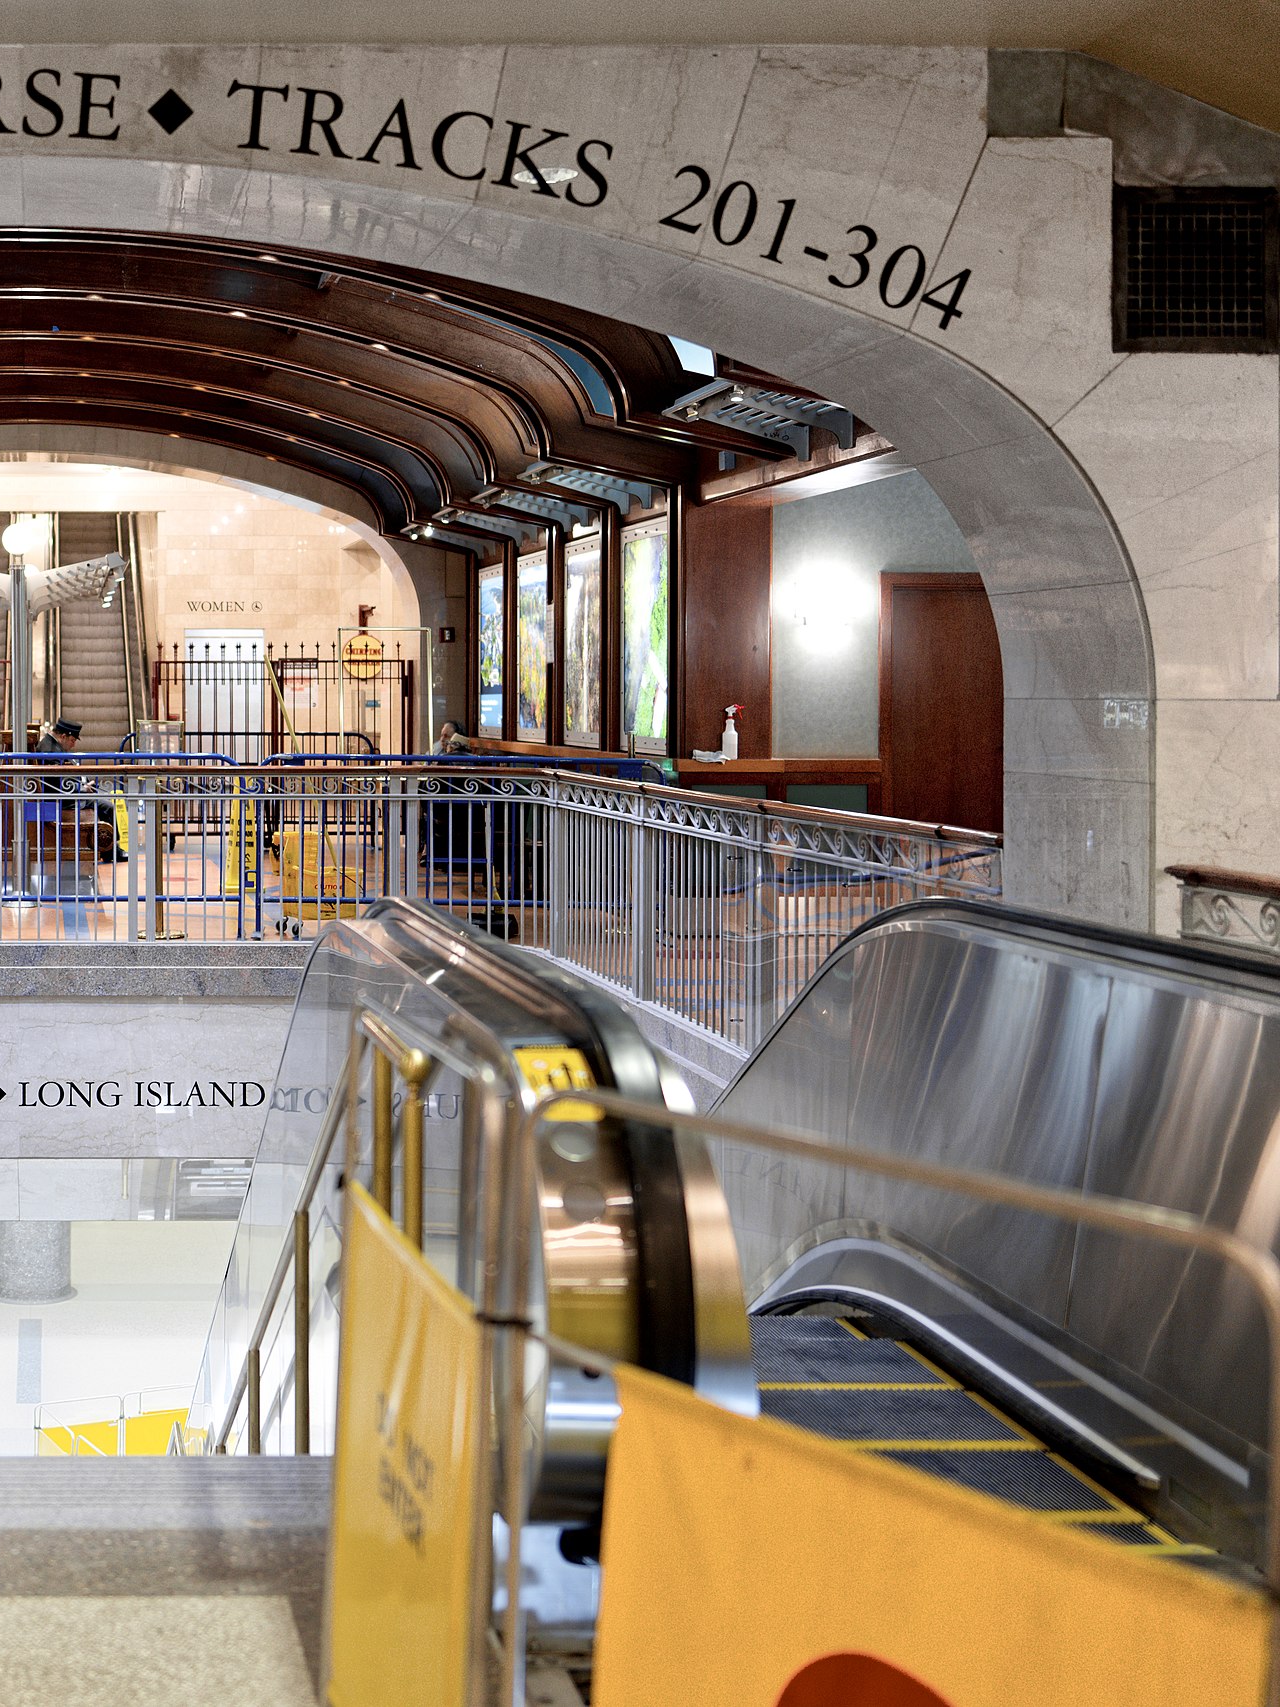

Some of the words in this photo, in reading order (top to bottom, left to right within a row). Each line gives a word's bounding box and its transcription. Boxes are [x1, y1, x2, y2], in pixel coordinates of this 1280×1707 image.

[227, 79, 613, 208] TRACKS
[658, 164, 972, 331] 201-304
[187, 601, 245, 612] WOMEN
[18, 1081, 124, 1108] LONG
[133, 1081, 266, 1108] ISLAND
